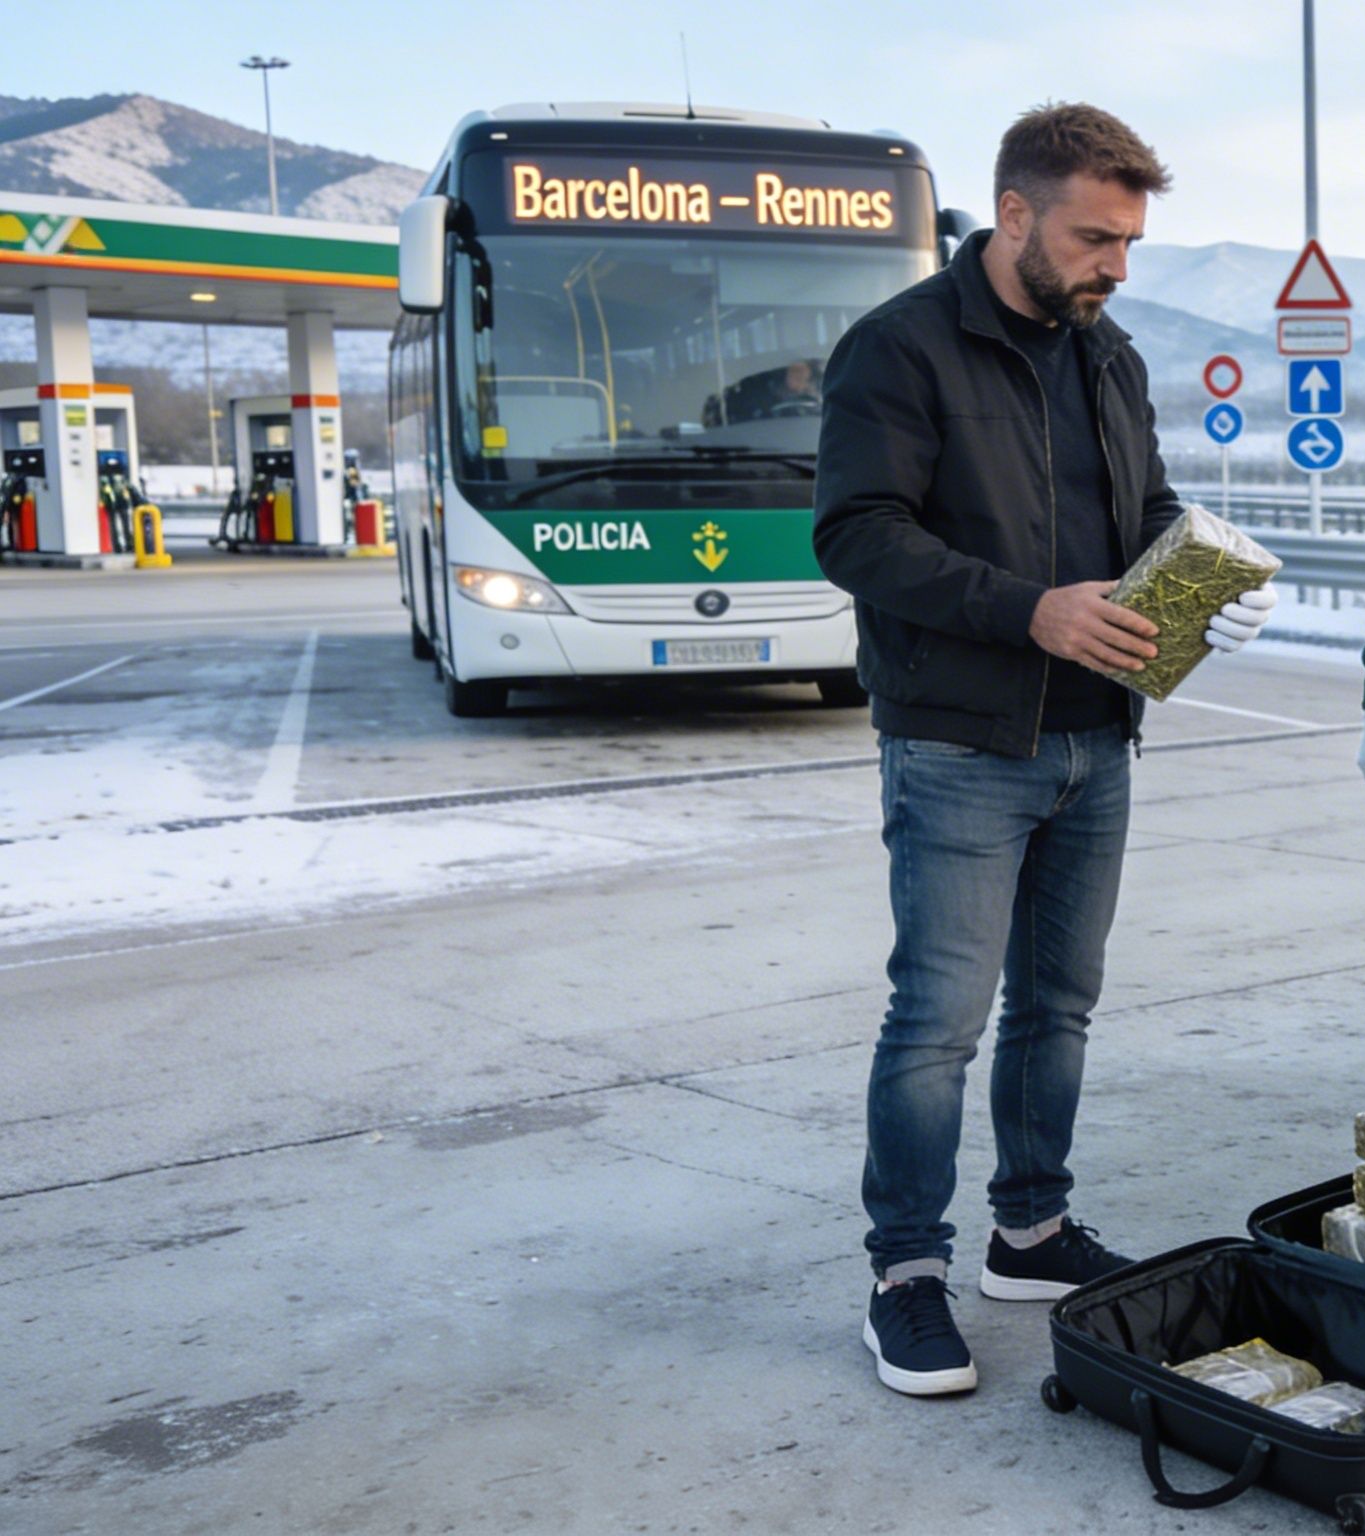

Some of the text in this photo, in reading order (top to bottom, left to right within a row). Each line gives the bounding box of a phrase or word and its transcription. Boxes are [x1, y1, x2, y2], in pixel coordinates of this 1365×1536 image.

[513, 165, 711, 222] Barcelona
[756, 173, 893, 229] Rennes
[533, 521, 651, 551] POLICIA
